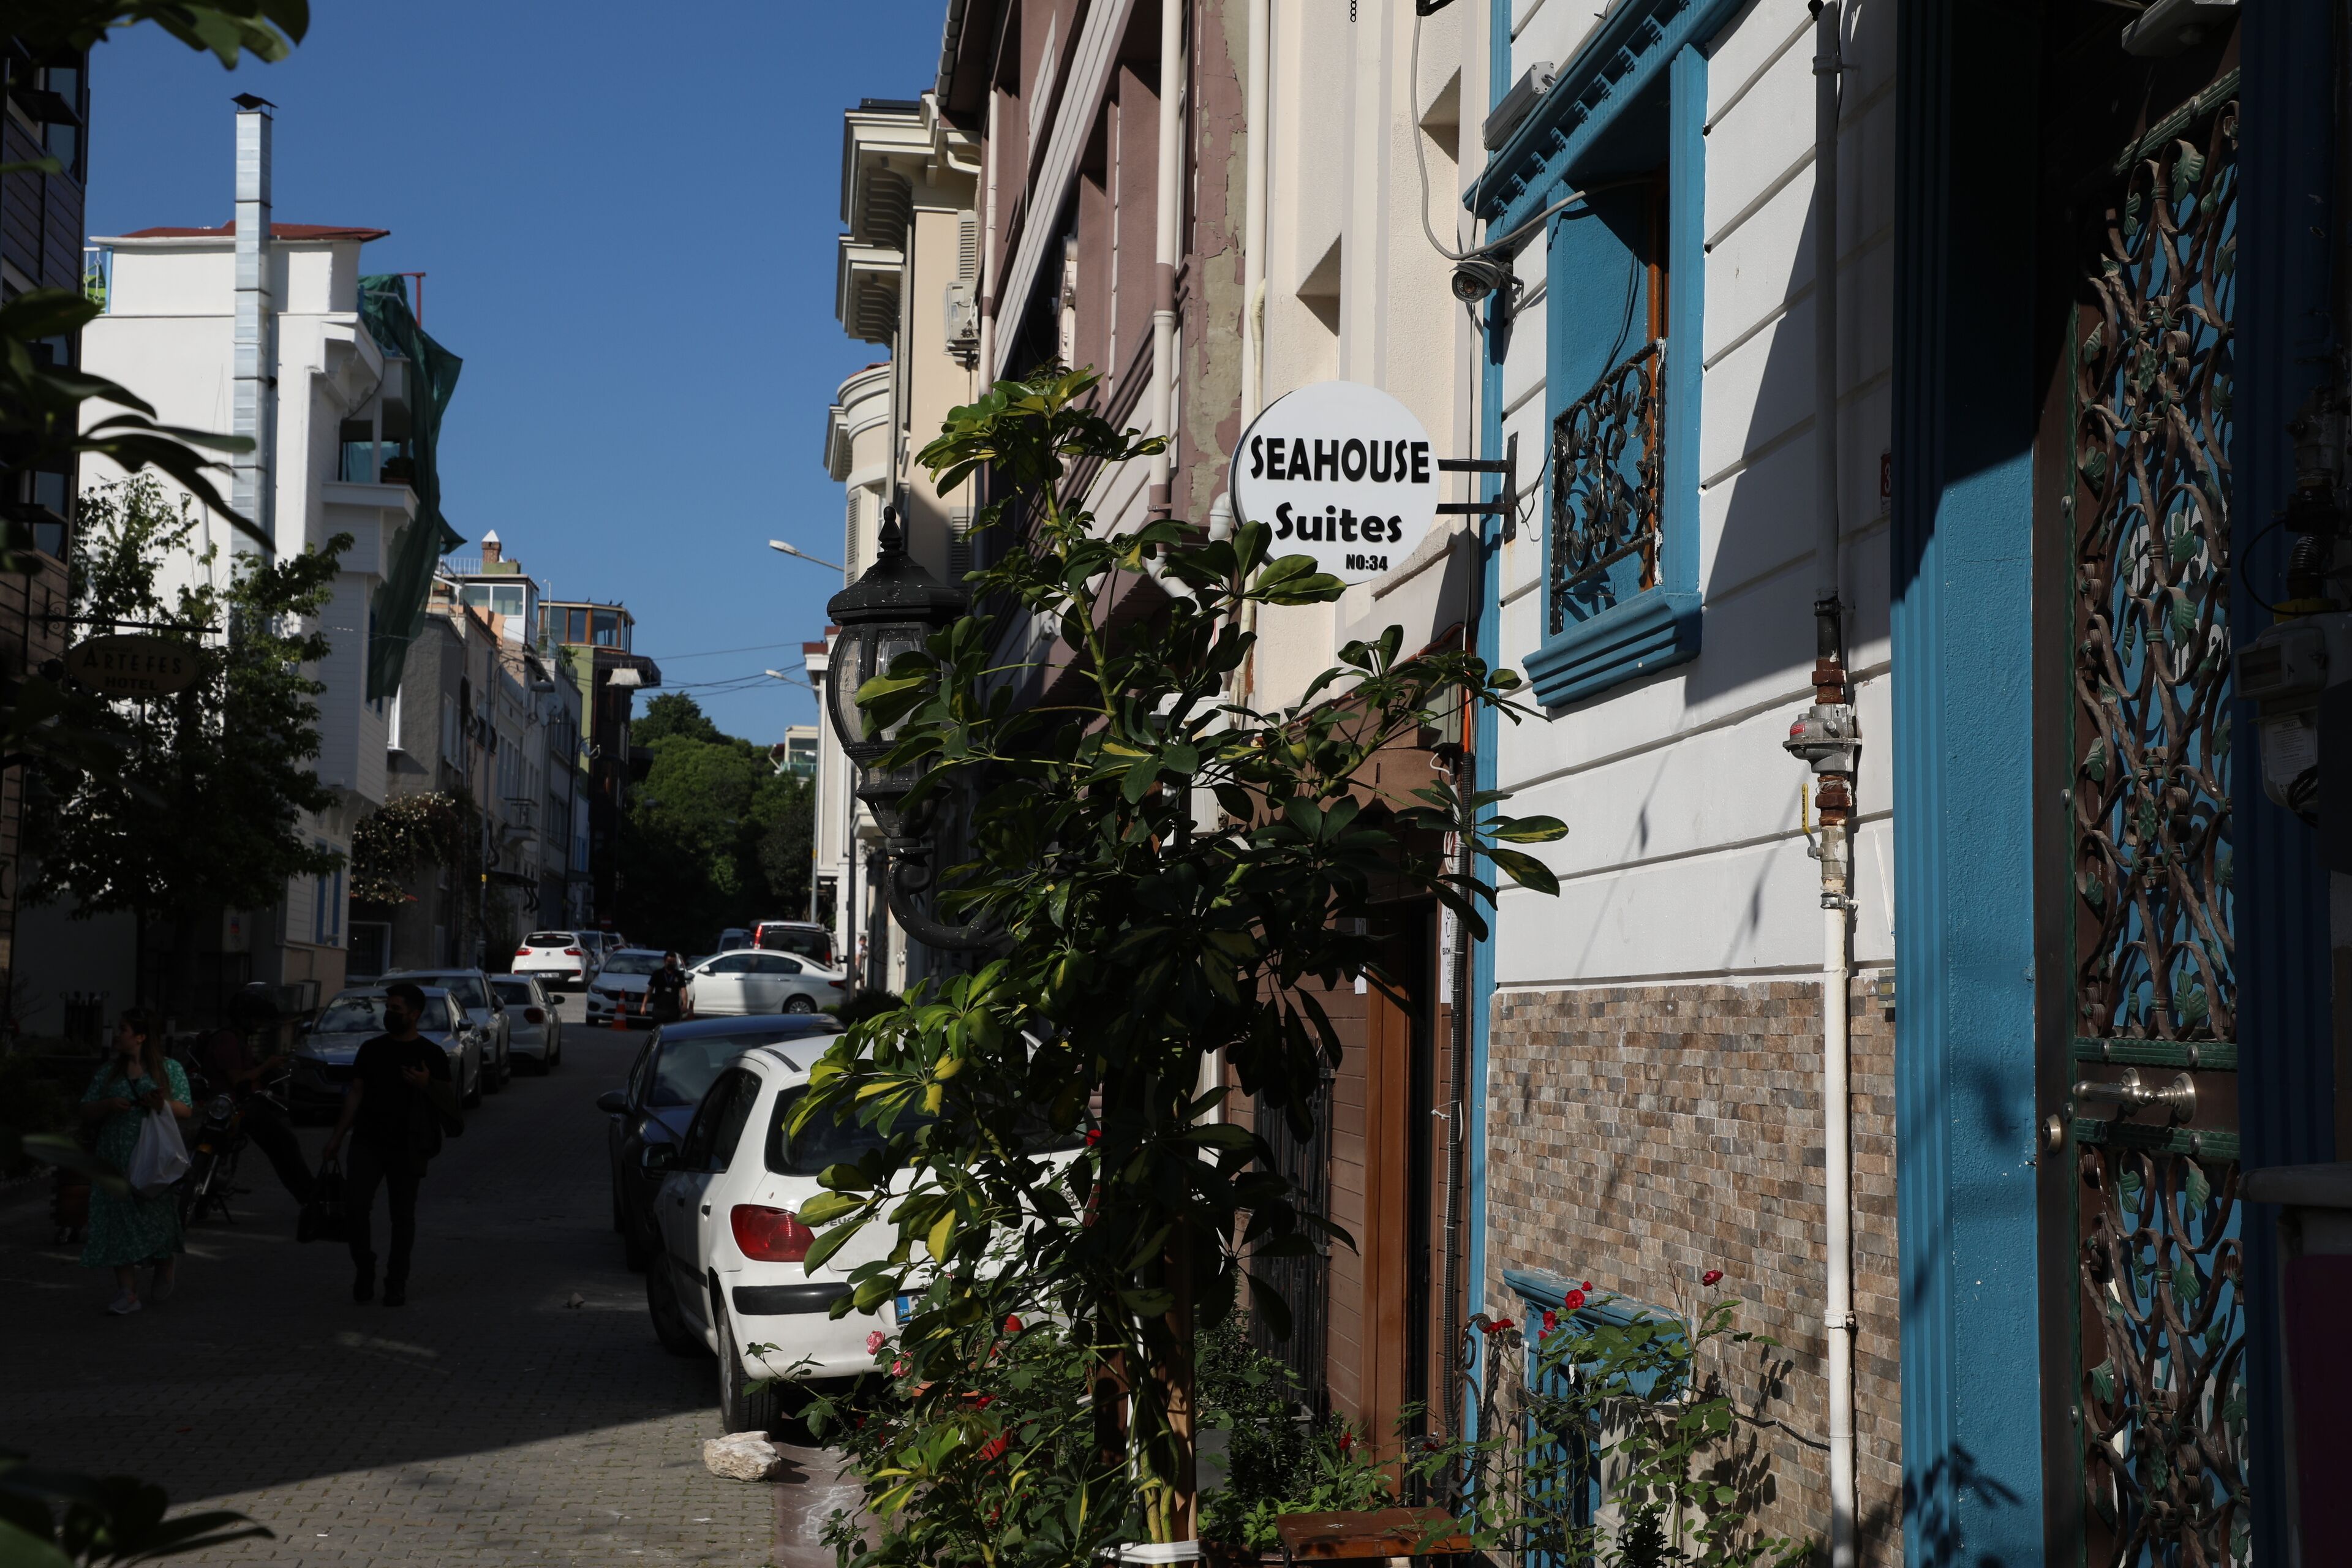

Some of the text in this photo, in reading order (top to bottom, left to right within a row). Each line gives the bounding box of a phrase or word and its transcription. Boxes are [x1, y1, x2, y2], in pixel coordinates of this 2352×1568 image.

[1250, 434, 1430, 483] SEAHOUSE
[1275, 502, 1403, 543] Suites
[1346, 554, 1388, 571] NO:34
[105, 676, 158, 690] HOTEL
[821, 1213, 881, 1227] PEUT
